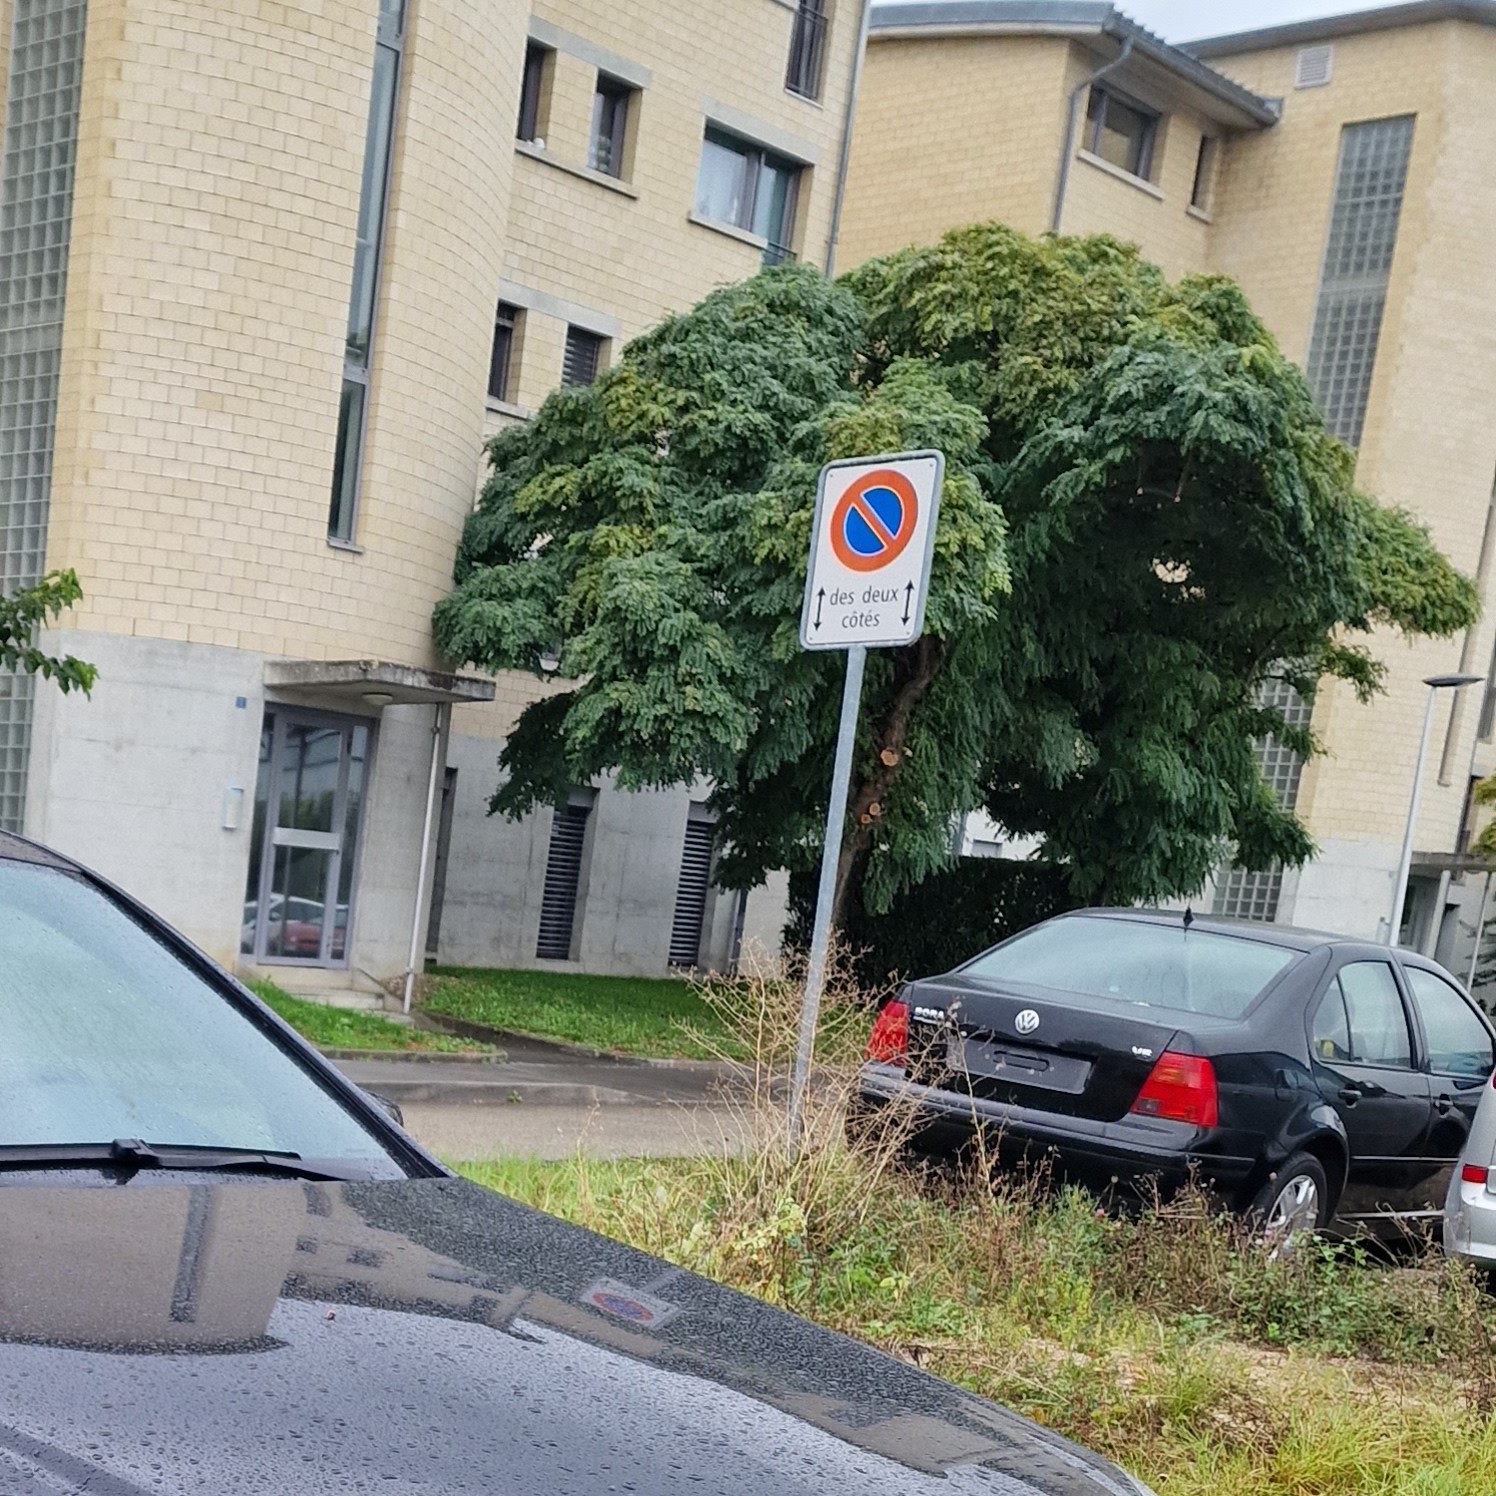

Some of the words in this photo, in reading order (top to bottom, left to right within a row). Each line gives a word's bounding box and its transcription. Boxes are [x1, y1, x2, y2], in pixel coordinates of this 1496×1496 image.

[830, 587, 854, 606] des
[862, 585, 899, 604] deux
[842, 609, 880, 629] côtés
